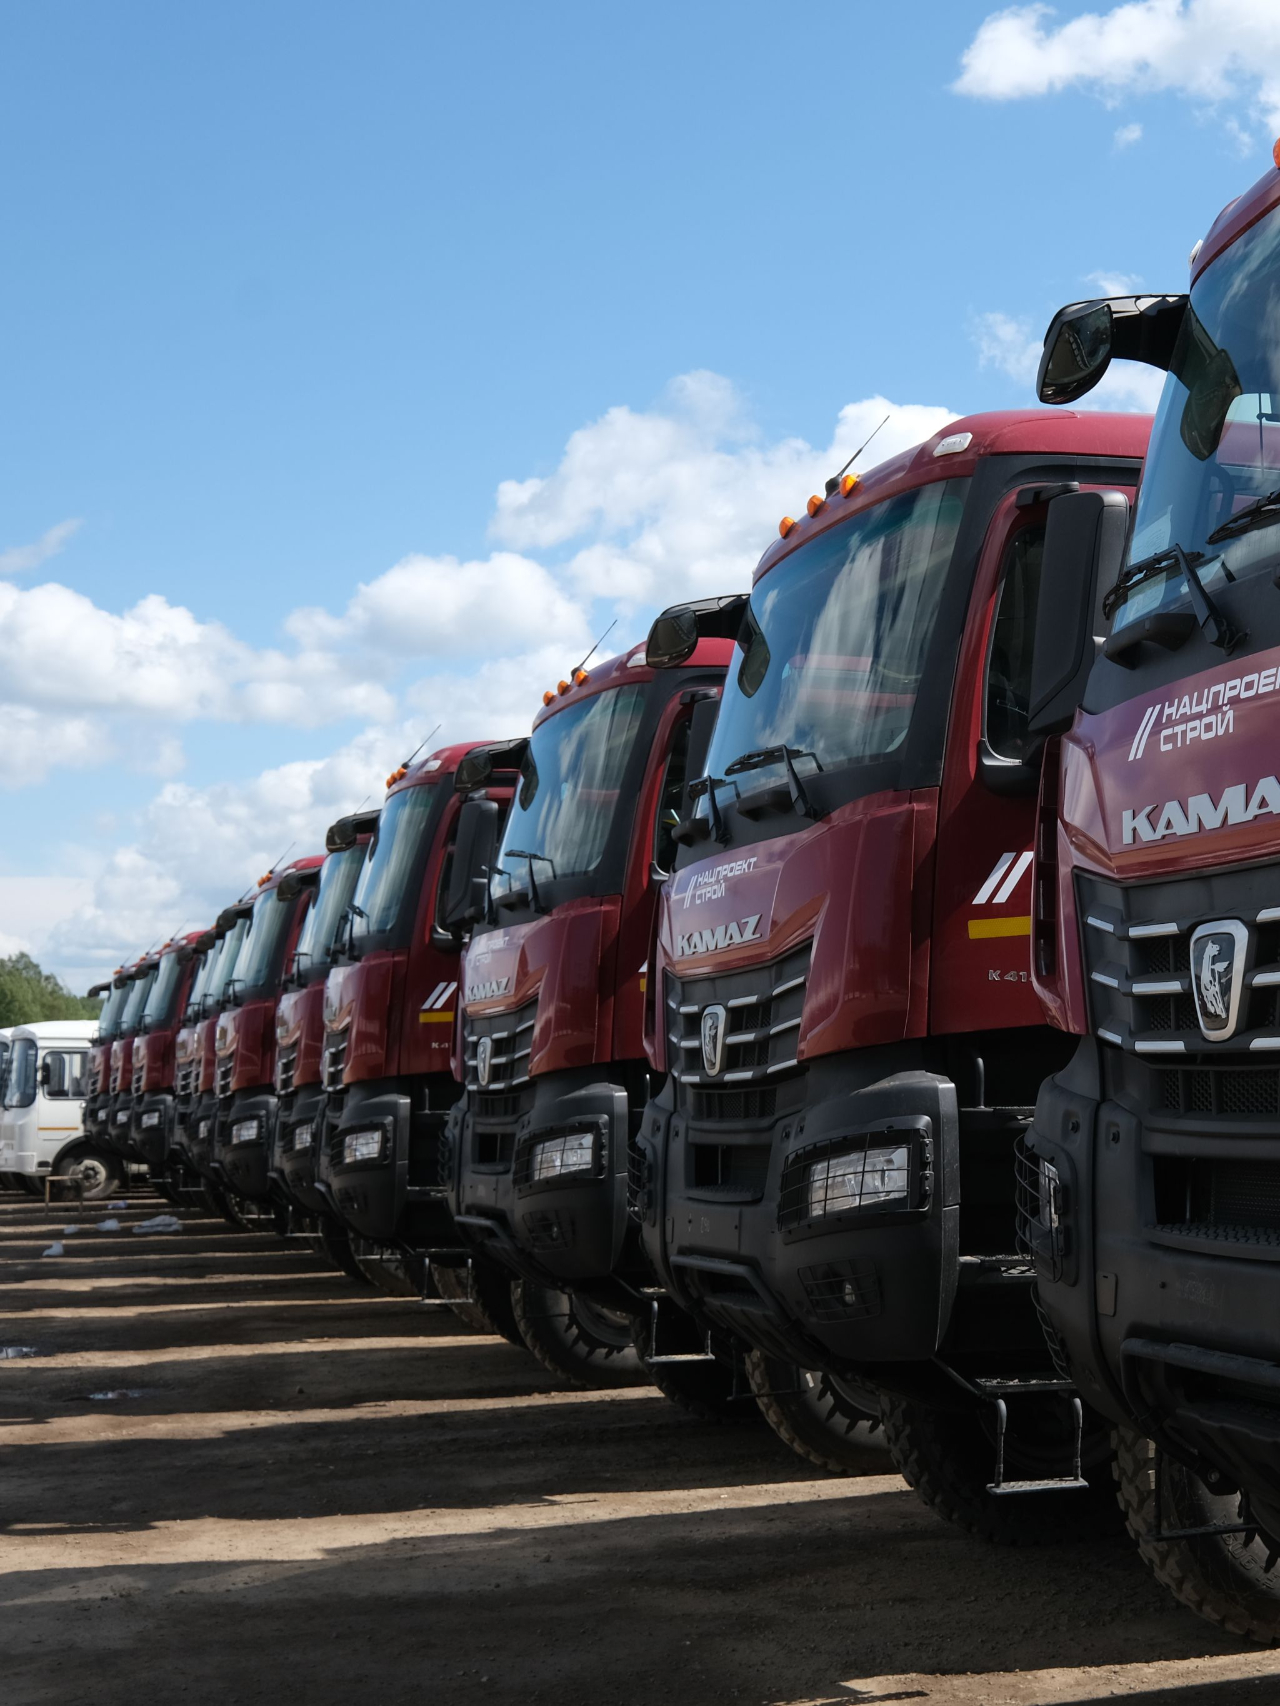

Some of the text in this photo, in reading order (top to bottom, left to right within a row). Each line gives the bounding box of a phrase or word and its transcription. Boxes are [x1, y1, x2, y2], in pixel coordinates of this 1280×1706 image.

[1160, 705, 1234, 752] СТРОЙ
[696, 857, 758, 887] НАЦПРОЕКТ
[695, 880, 725, 905] СТРОЙ
[677, 914, 762, 957] KAMAZ
[467, 977, 510, 1002] KAMAZ
